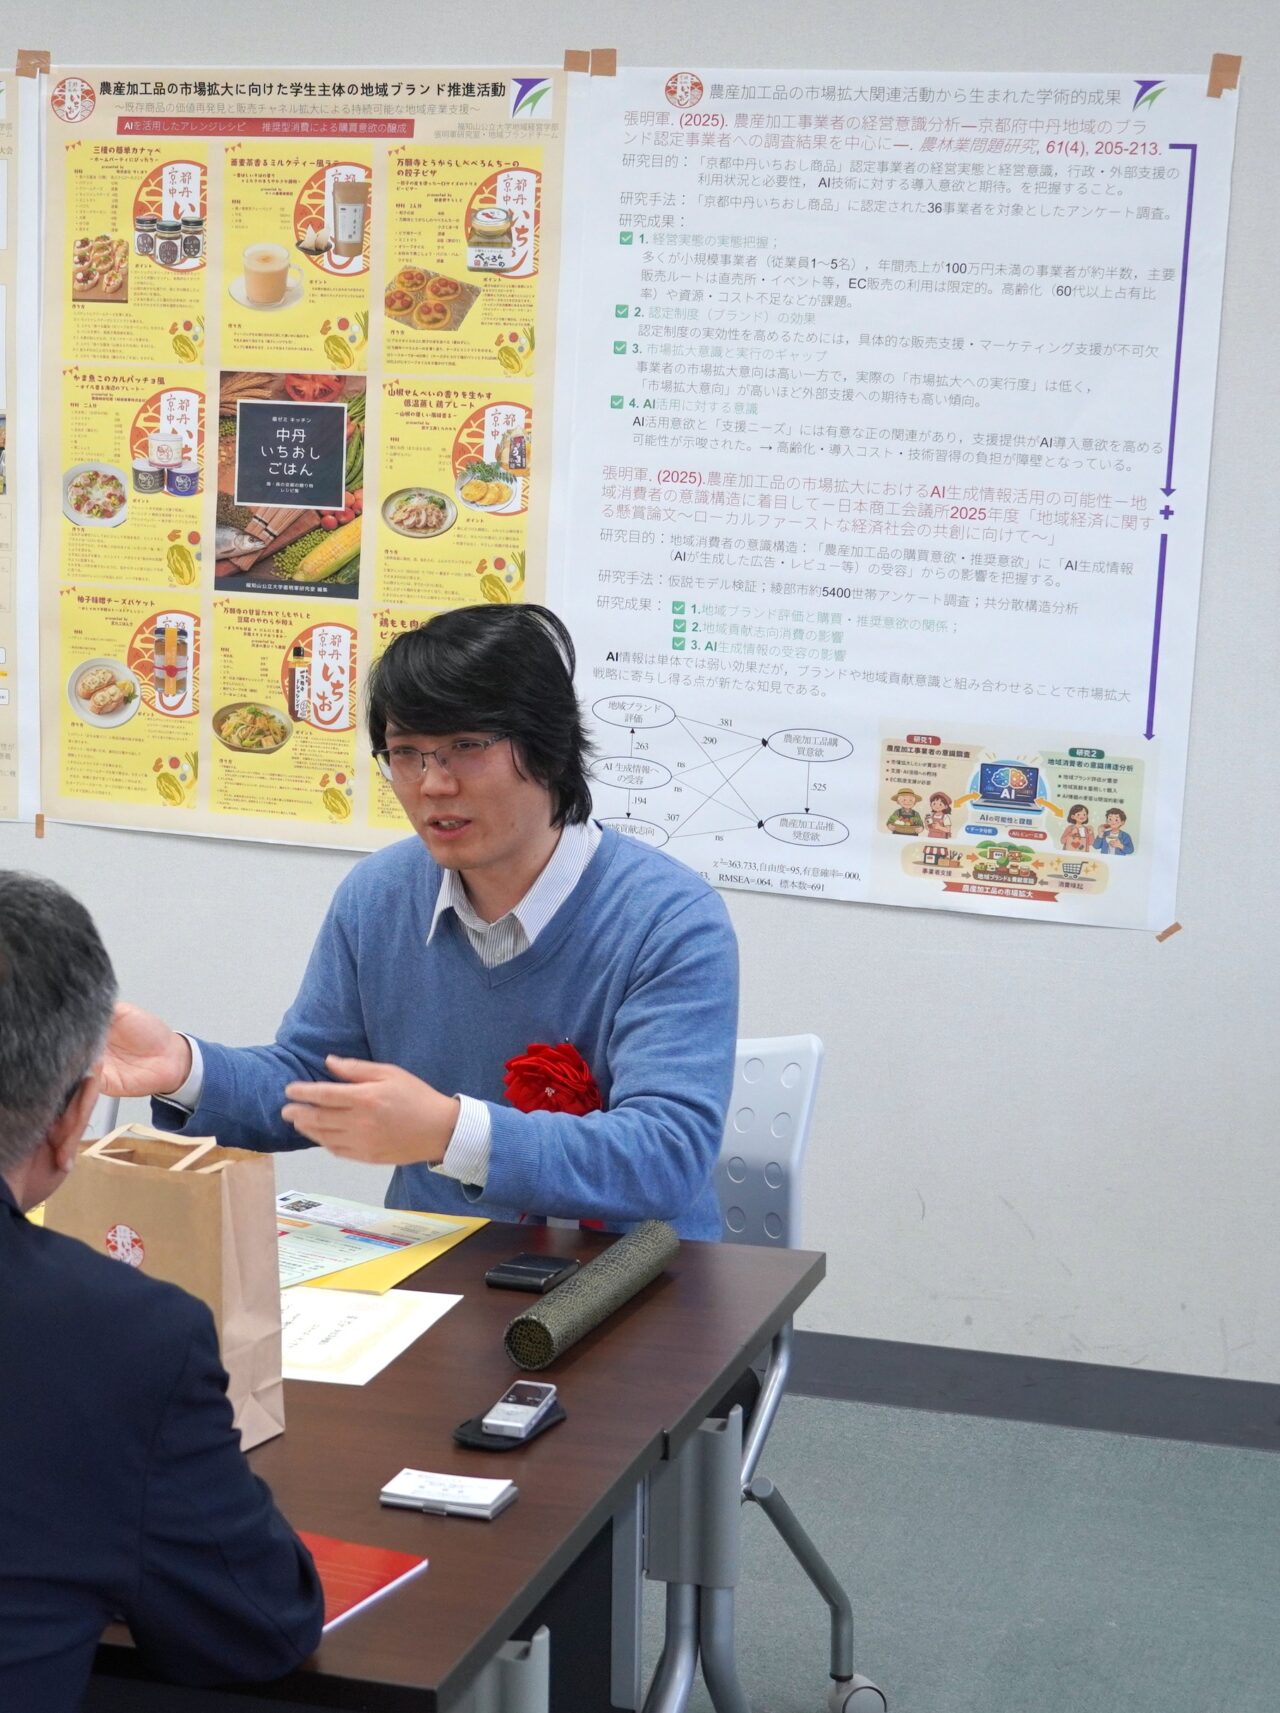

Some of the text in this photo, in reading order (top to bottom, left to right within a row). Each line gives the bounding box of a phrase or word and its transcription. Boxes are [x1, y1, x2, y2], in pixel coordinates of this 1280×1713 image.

[99, 81, 506, 97] 農産加工品の市場拡大に向けた学生主体の地域ブランド推進活動
[709, 84, 1121, 106] 農産加工品の市場拡大関連活動から生まれた学術的成果
[124, 120, 246, 132] AIを活用したアレンジレシピ
[624, 110, 674, 127] 張明軍.
[679, 113, 728, 129] (2025).
[1046, 141, 1089, 157] 61(4),
[1094, 141, 1162, 156] 205-213.
[622, 153, 688, 169] 研究目的：
[168, 167, 192, 185] 京都
[503, 174, 527, 192] 京都
[168, 187, 192, 198] 中丹
[503, 194, 527, 206] 中丹
[620, 192, 686, 207] 研究手法：
[619, 213, 685, 229] 研究成果：
[166, 394, 190, 412] 京都
[643, 399, 758, 415] AI活用に対する意識
[167, 413, 190, 424] 中丹
[491, 408, 516, 427] 京都
[276, 428, 306, 443] 中丹
[261, 445, 320, 460] いちおし
[268, 462, 313, 477] ごはん
[602, 465, 652, 482] 張明軍.
[600, 528, 665, 545] 研究目的：
[598, 569, 663, 586] 研究手法：
[597, 595, 661, 612] 研究成果：
[318, 629, 342, 648] 京都
[318, 649, 342, 661] 中丹
[624, 713, 643, 724] 評価
[634, 742, 649, 751] .263
[702, 736, 717, 745] .290
[913, 735, 933, 745] 研究1
[1076, 749, 1097, 758] 研究2
[603, 762, 613, 771] AI
[810, 783, 827, 792] .525
[1000, 789, 1016, 799] AI
[632, 796, 647, 805] .194
[664, 813, 680, 822] .307
